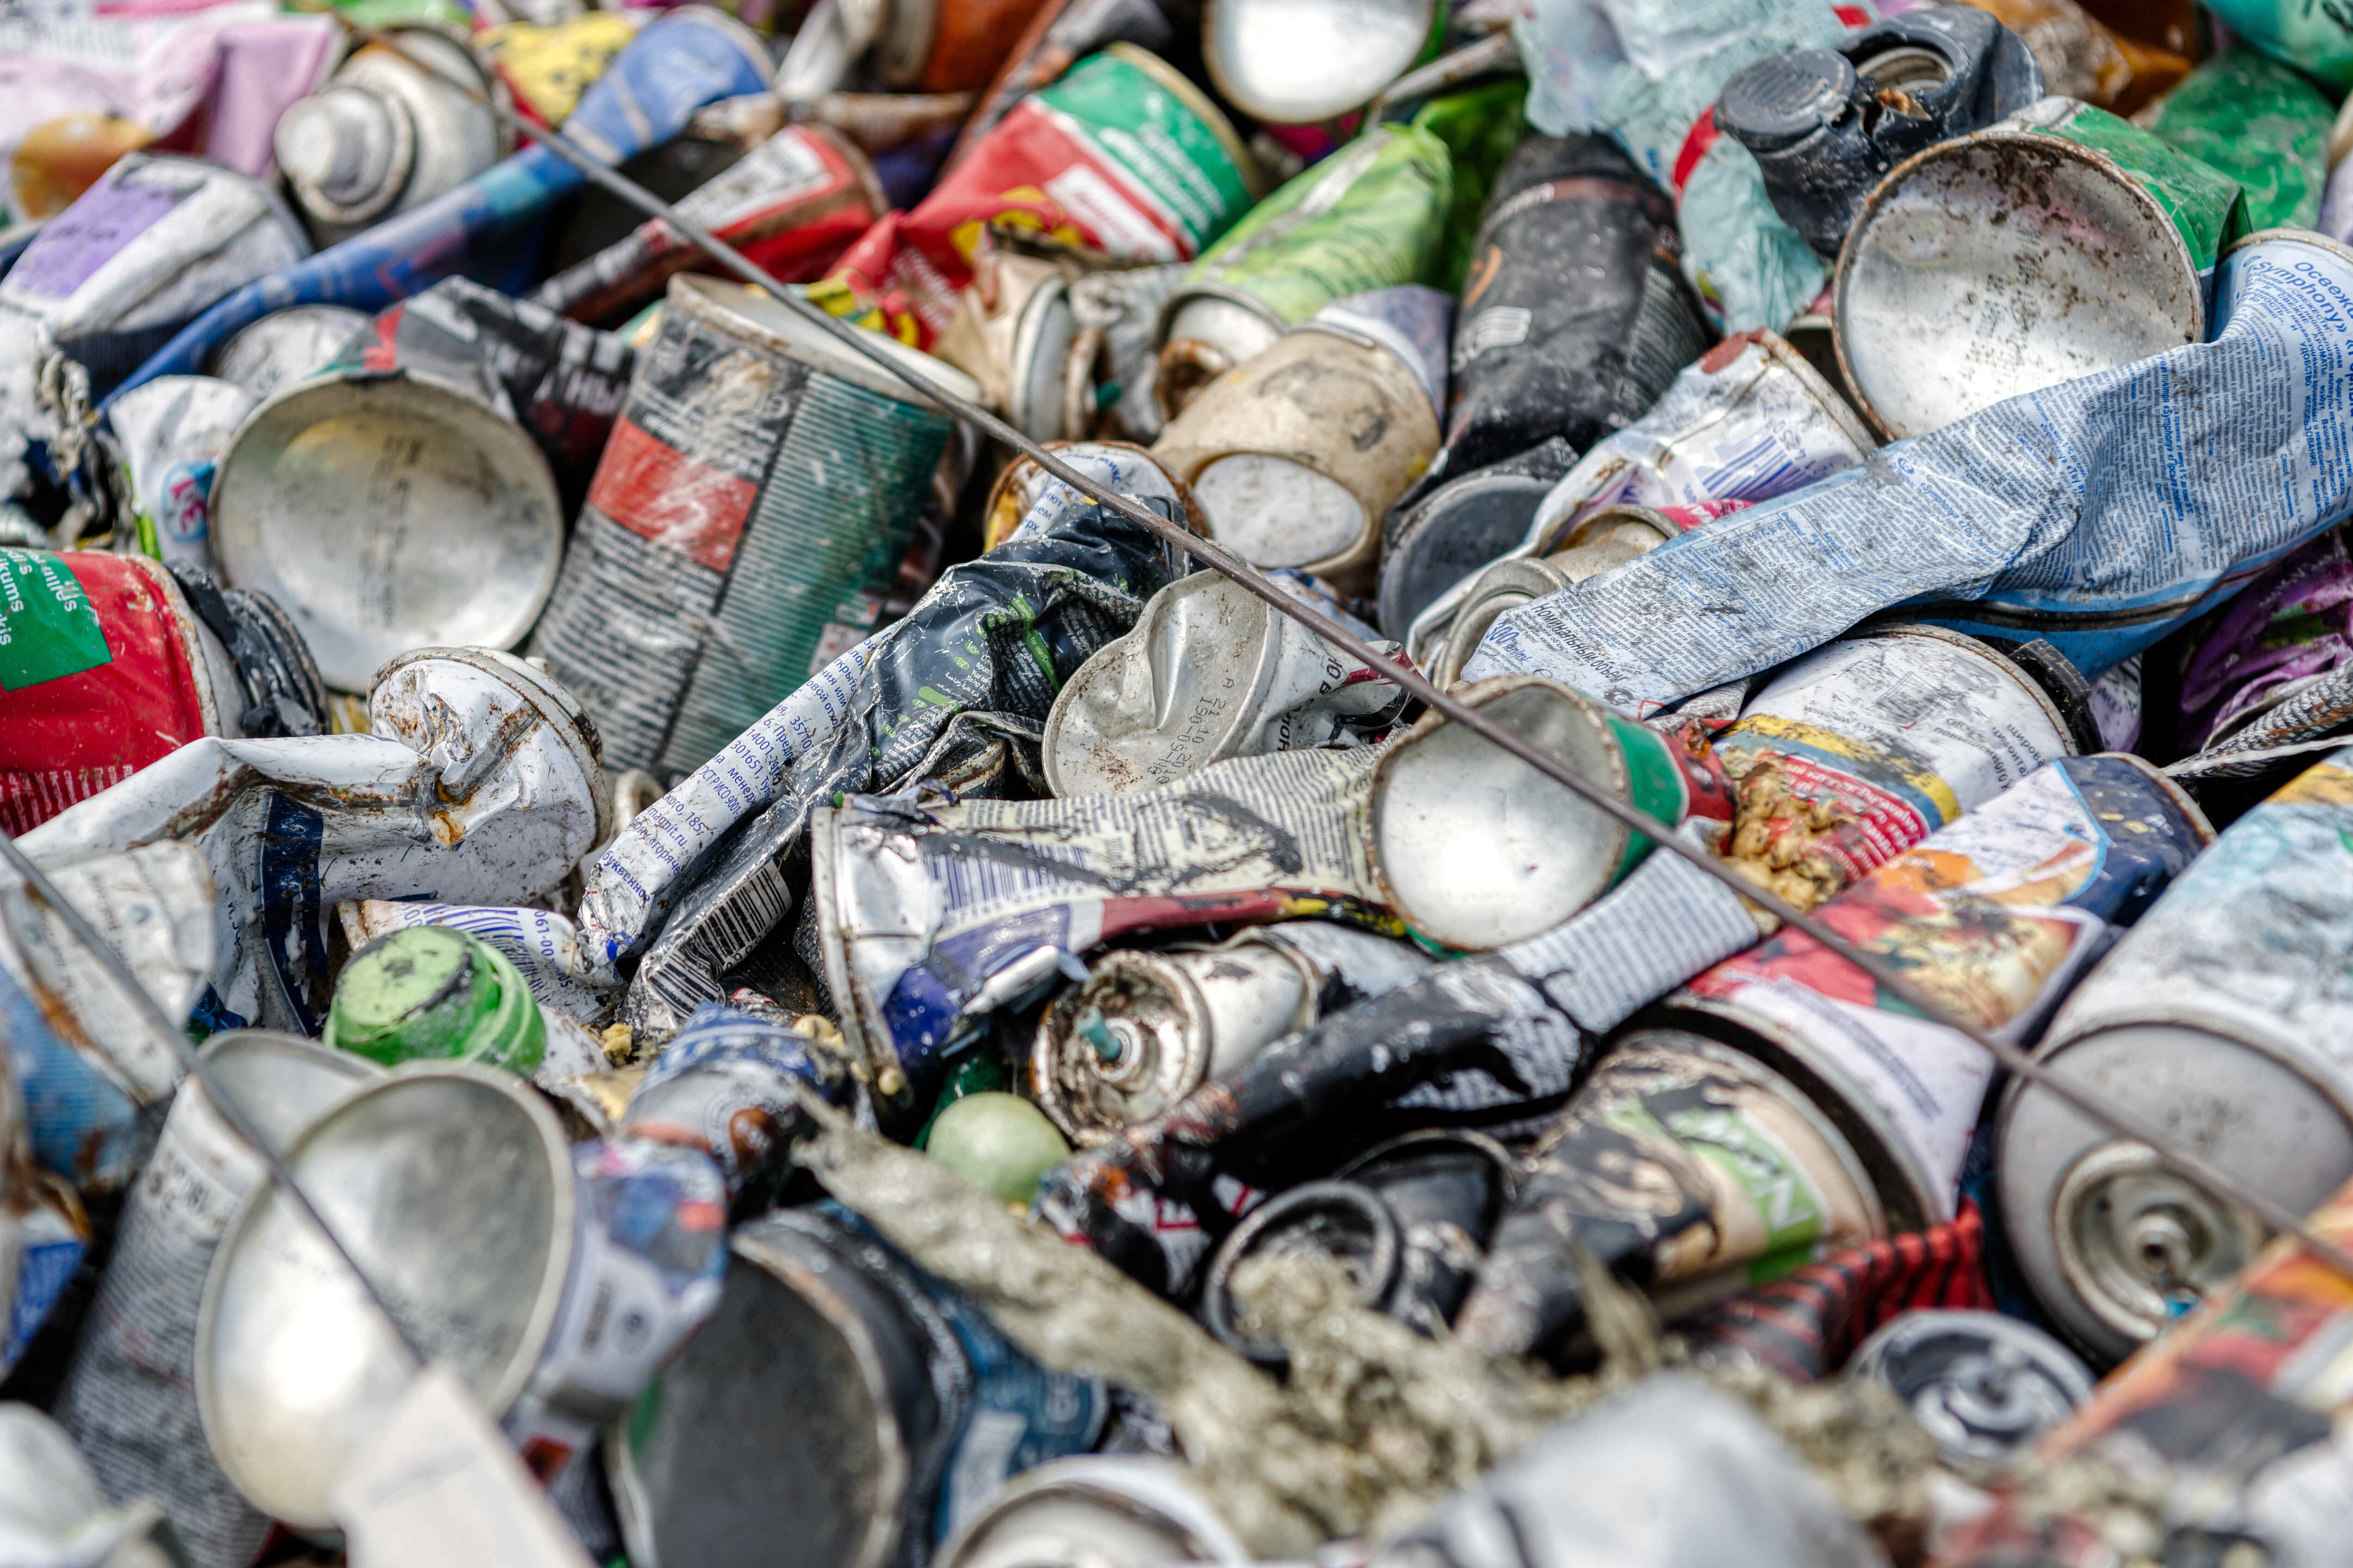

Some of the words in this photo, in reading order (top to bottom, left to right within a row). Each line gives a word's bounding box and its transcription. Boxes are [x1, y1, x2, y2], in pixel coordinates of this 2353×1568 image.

[1809, 531, 1846, 572] Изготовитель
[1486, 621, 1520, 644] 300
[835, 686, 848, 708] или
[730, 740, 763, 780] 301651,
